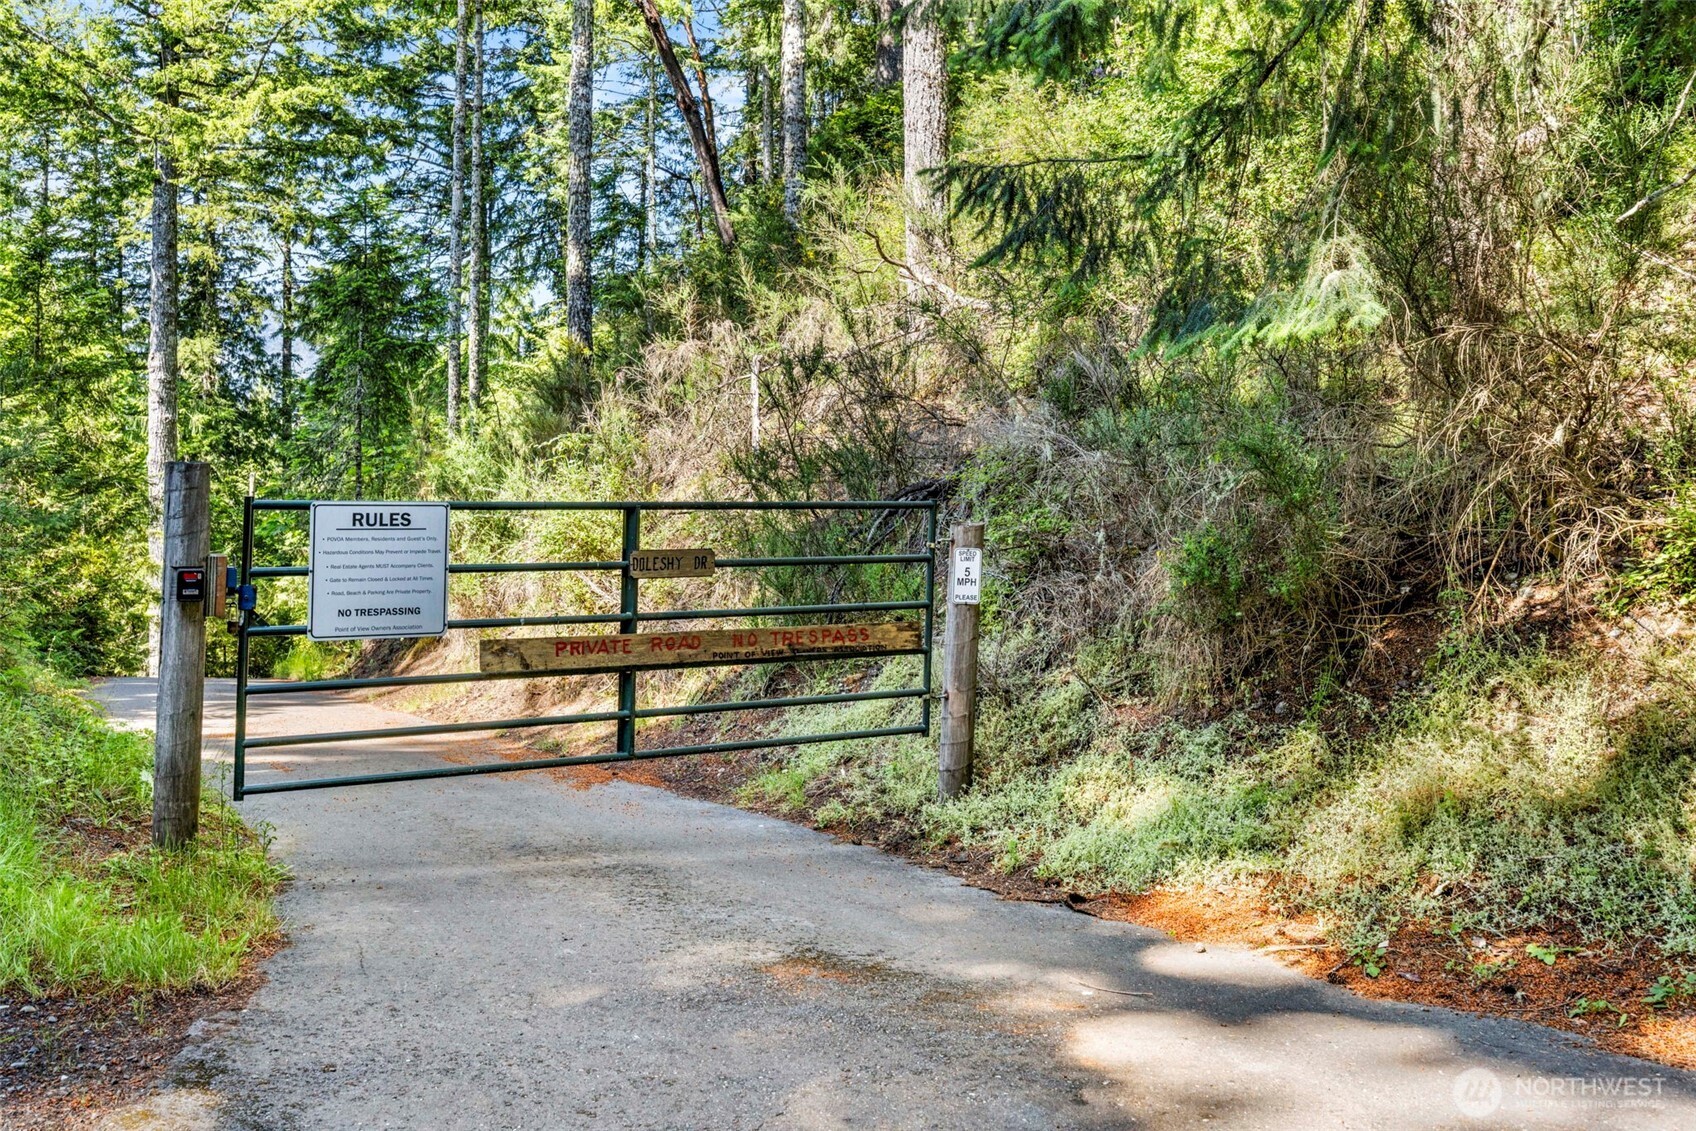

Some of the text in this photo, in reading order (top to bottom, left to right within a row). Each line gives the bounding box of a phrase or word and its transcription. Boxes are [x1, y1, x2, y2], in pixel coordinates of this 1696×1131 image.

[352, 512, 412, 527] RULES
[632, 556, 684, 572] DOLESHY
[964, 566, 970, 577] 5
[956, 578, 977, 586] MPH
[338, 606, 421, 617] NO TRESPASSING
[555, 628, 870, 657] PRIVATE ROAD NO TRESPASS
[712, 652, 739, 660] POINT
[761, 648, 784, 656] VIEW
